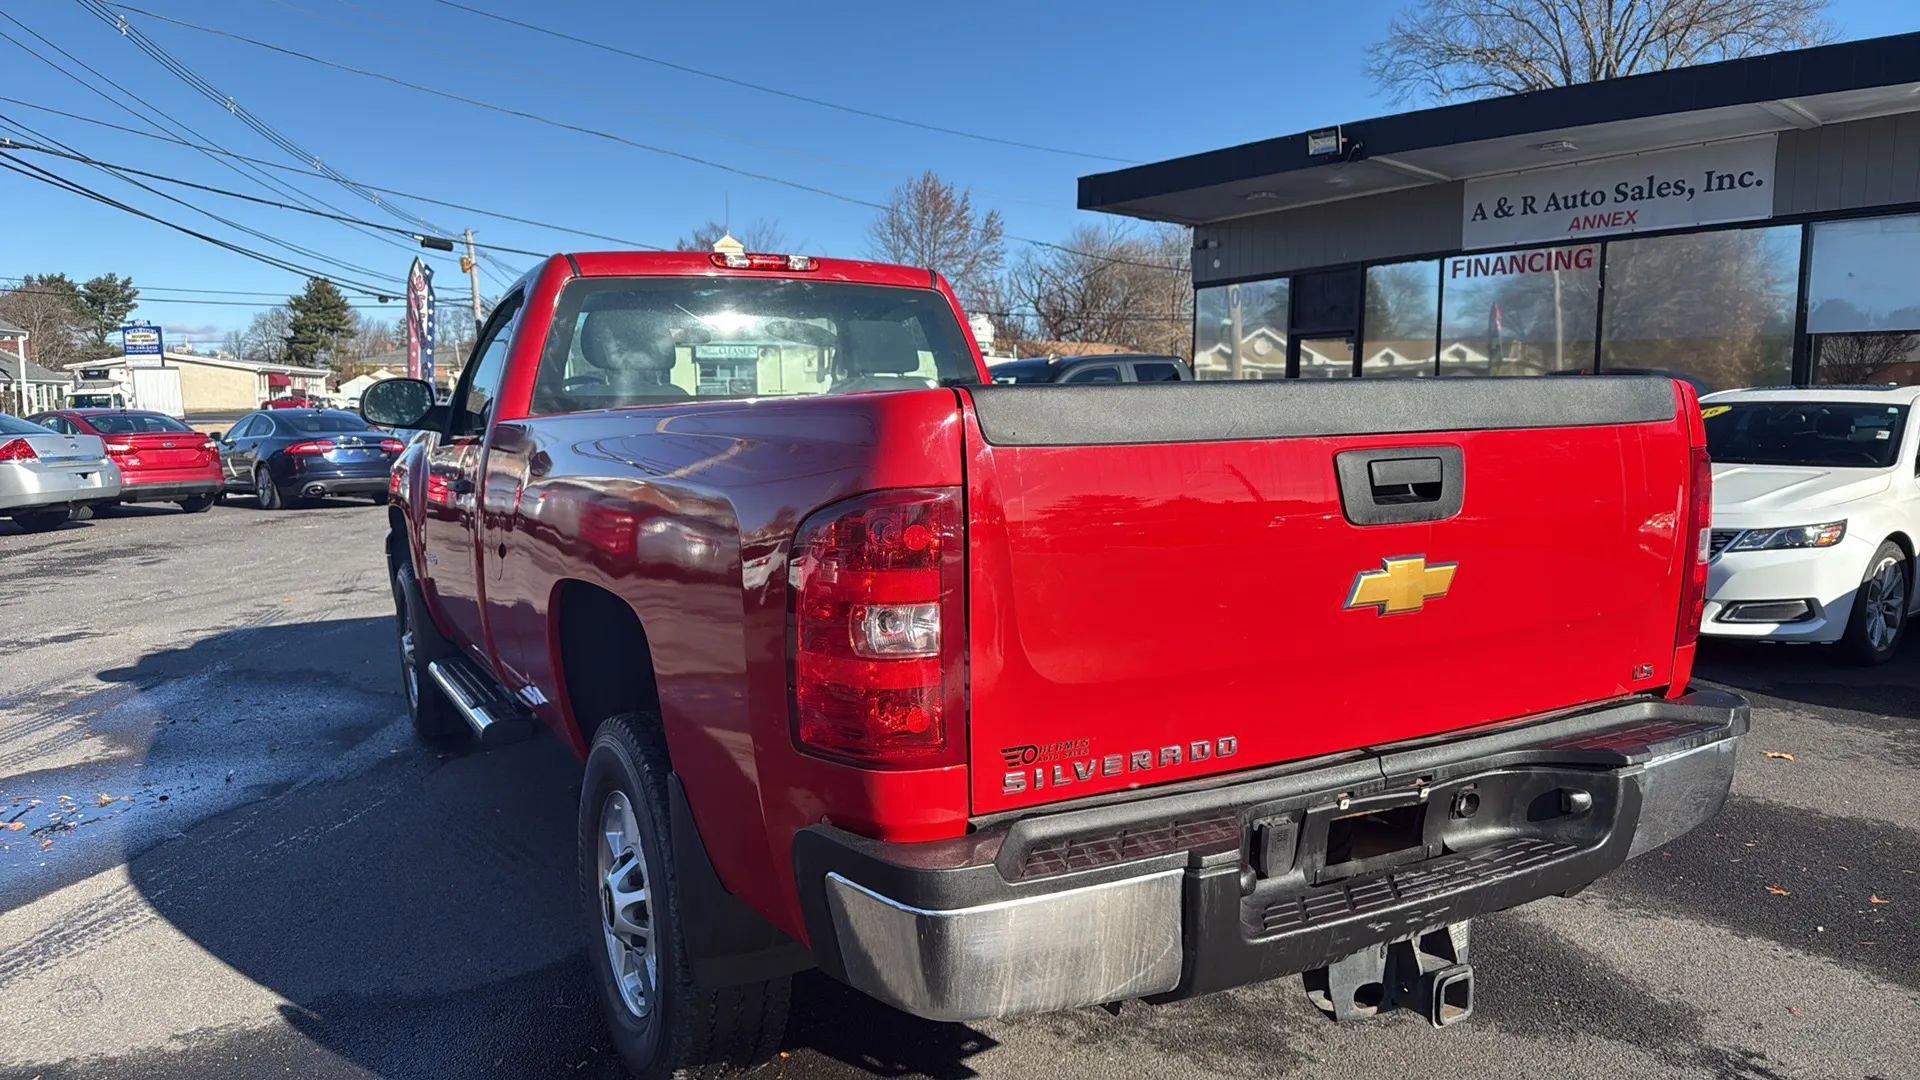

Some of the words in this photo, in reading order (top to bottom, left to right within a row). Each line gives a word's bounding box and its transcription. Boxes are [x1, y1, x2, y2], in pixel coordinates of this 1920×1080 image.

[1471, 202, 1487, 222] A
[1493, 197, 1514, 218] &
[1521, 195, 1538, 216] R
[1544, 189, 1606, 213] Auto
[1614, 175, 1696, 202] Sales,
[1703, 169, 1764, 193] Inc.
[1568, 209, 1639, 232] ANNEX
[1451, 248, 1594, 279] FINANCING
[1039, 738, 1089, 754] HERMES
[1063, 749, 1089, 760] SALES
[1003, 735, 1238, 796] SILVERADO
